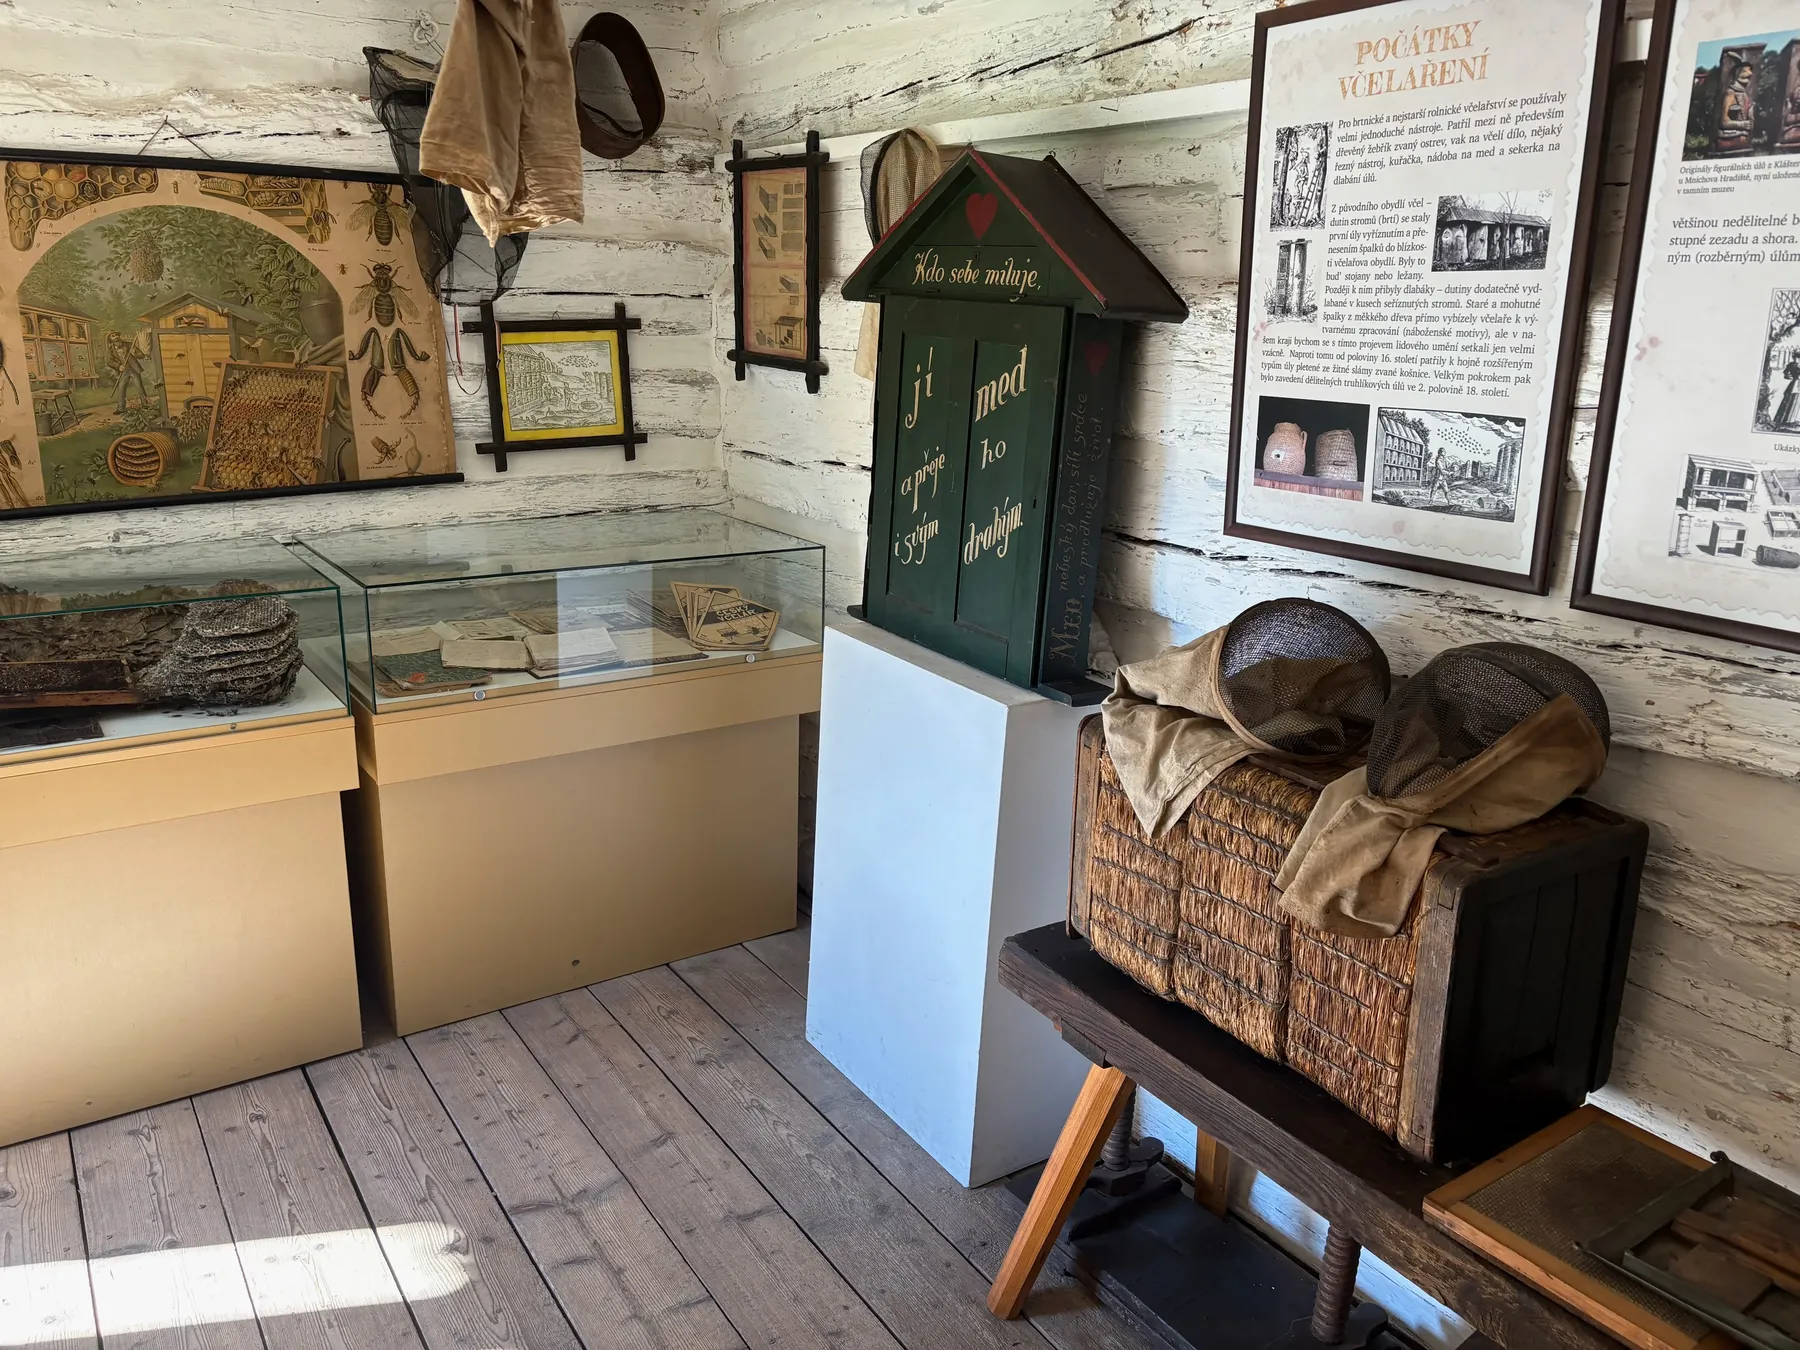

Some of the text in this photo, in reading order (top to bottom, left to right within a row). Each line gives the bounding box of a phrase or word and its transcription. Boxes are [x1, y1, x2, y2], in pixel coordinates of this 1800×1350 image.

[1355, 20, 1483, 65] POČÁTKY
[1338, 47, 1491, 100] VČELAŘENÍ
[1338, 91, 1567, 129] Pro brtnické nejstarší rolnické včelařství používaly
[1336, 108, 1564, 143] velmi jednoduché nástroje. Patřil mezi především
[1335, 123, 1563, 157] dřevěný žebřík zvaný ostrev, vak včelí dílo, nějaký
[1334, 142, 1544, 172] řezný nástroj, kuřačka, nádoba med sekerka
[1333, 172, 1377, 185] dlabání úlů.
[1338, 197, 1424, 215] původního obydlí včel
[1329, 212, 1431, 226] dutin stromů (brtí) staly
[1672, 217, 1718, 228] většinou
[1722, 214, 1788, 227] nedělitelné
[1328, 227, 1428, 243] první vyříznutím pře-
[1668, 232, 1798, 248] stupné zezadu shora.
[1327, 241, 1427, 255] nesením špalků blízkos-
[1666, 251, 1691, 265] ným
[1695, 250, 1765, 265] (rozběrným)
[1333, 256, 1416, 268] včelařova obydlí. Byly
[911, 248, 1042, 302] Kdo sebe miluje,
[1344, 271, 1371, 282] stojany
[1374, 270, 1393, 280] nebo
[1396, 270, 1424, 282] ležany.
[1324, 283, 1542, 296] Později přibyly dlabáky dutiny dodatečně vyd-
[1323, 298, 1541, 310] labané kusech seříznutých stromů. Staré mohutné
[1322, 311, 1538, 326] špalky měkkého dřeva přímo vybízely včelaře vý-
[1321, 324, 1537, 340] tvarnému zpracování (náboženské motivy), ale na-
[1262, 335, 1535, 355] šem kraji bychom tímto projevem lidového umění setkali jen velmi
[1261, 347, 1533, 371] vzácně. Naproti tomu poloviny 16. století patřily hojně rozšířeným
[1260, 372, 1510, 397] bylo zavedení dělitelných truhlíkových úlů polovině 18. století.
[1261, 360, 1531, 386] typům pletené žitné slámy zvané košnice. Velkým pokrokem pak
[904, 344, 1029, 429] jí med
[1071, 393, 1088, 449] srdce
[901, 438, 1007, 515] a přeje ho
[1061, 481, 1080, 516] dar,
[894, 496, 1024, 565] i svým drahým.
[1079, 474, 1104, 569] prodlužuje
[1056, 521, 1078, 591] nebeský
